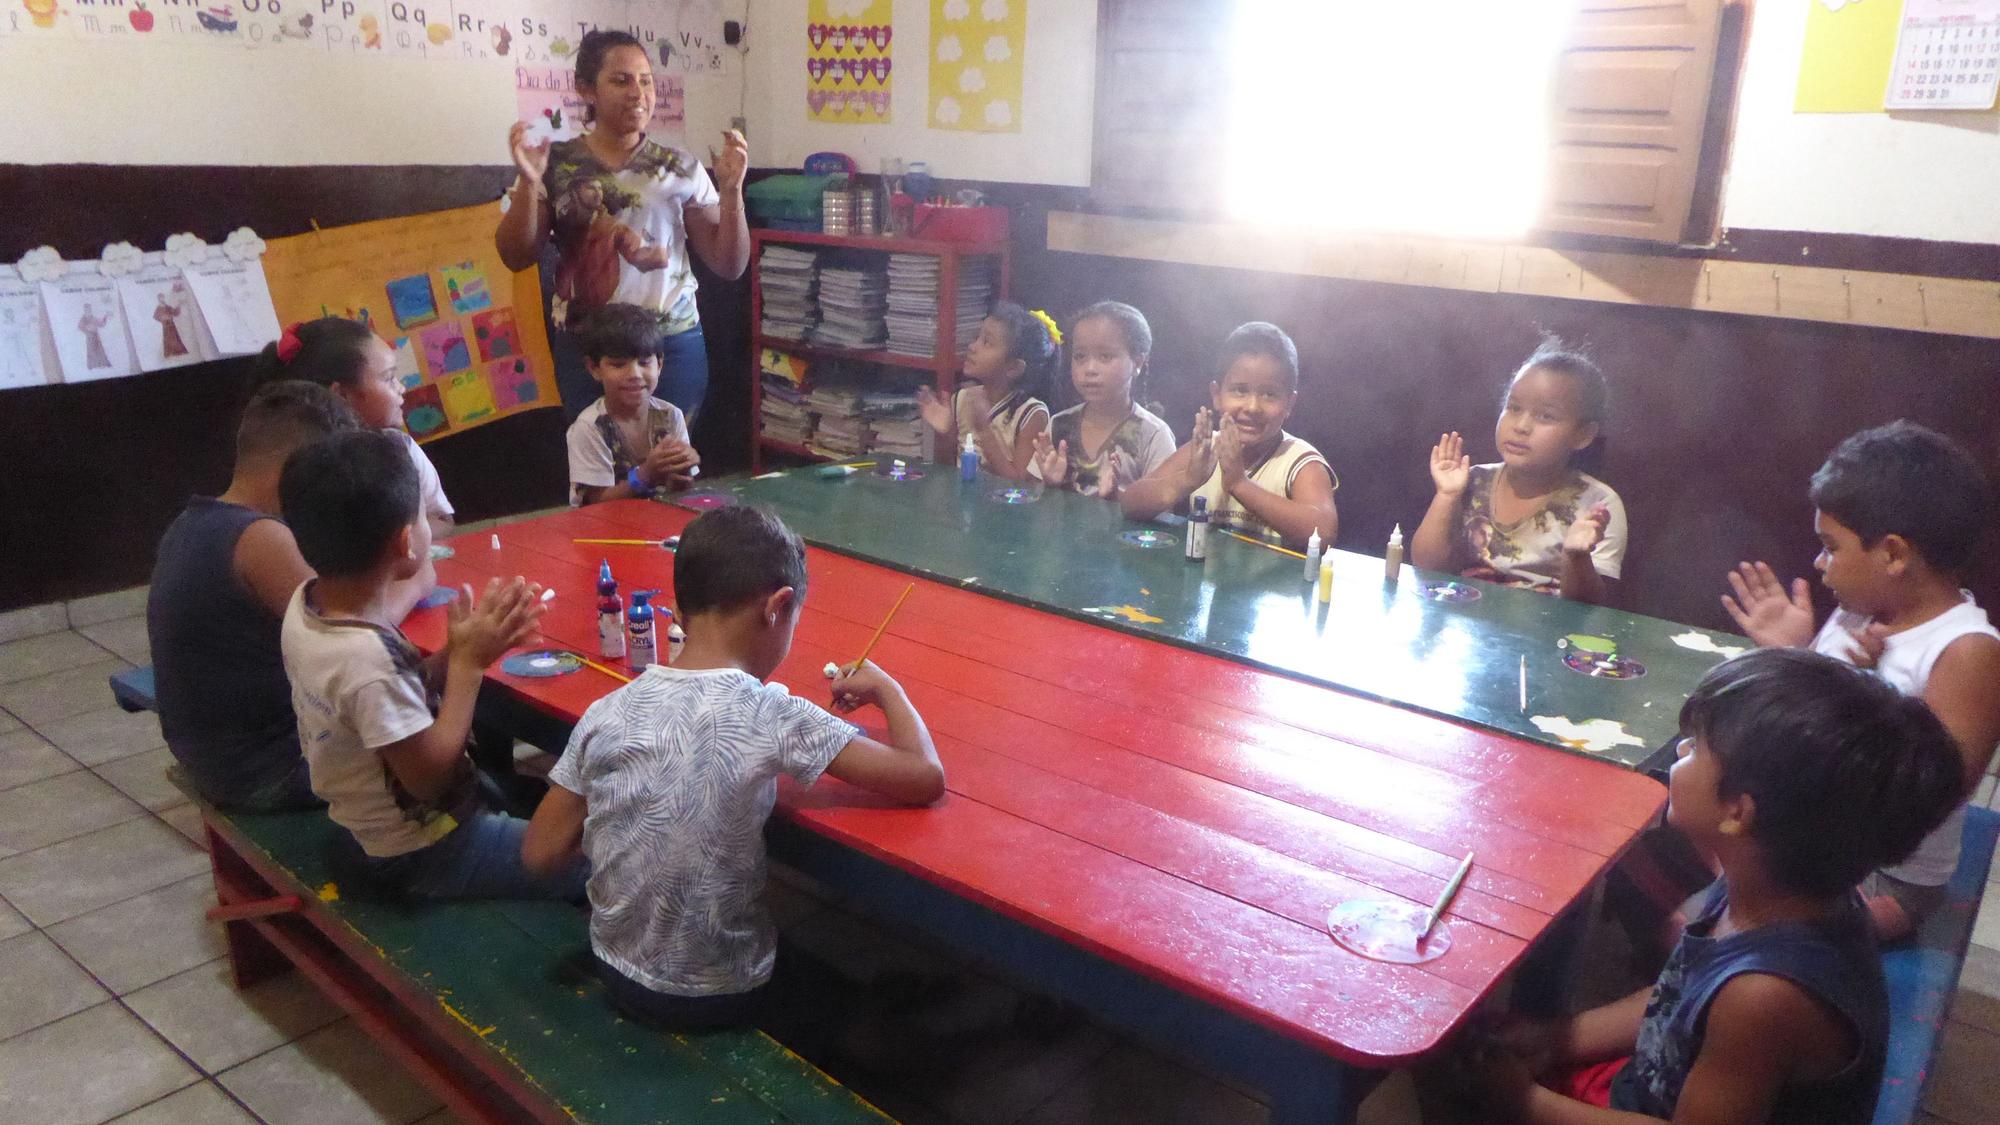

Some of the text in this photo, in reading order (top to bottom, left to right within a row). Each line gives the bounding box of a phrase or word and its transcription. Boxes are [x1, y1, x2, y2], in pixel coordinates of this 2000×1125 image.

[341, 1, 355, 20] p
[391, 2, 427, 28] Q q
[458, 13, 486, 33] R r
[521, 17, 548, 37] S s
[679, 31, 703, 49] V v
